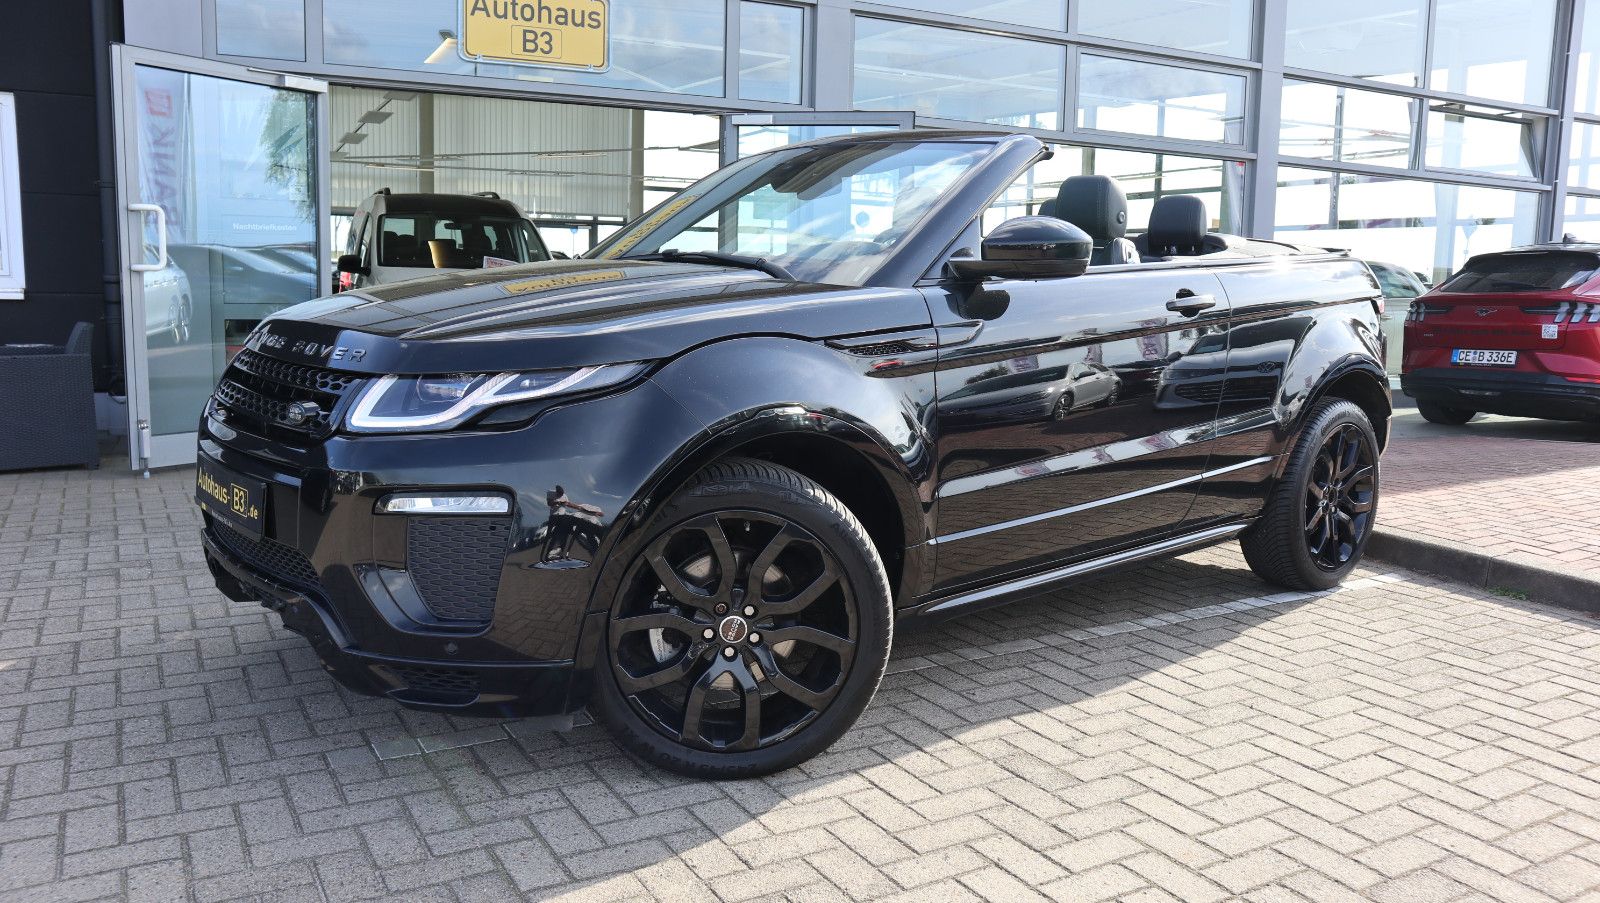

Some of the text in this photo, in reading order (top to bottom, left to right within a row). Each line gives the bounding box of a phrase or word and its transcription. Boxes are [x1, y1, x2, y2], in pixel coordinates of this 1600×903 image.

[470, 0, 602, 30] Autohaus
[522, 29, 554, 55] B3
[292, 341, 367, 362] ROVER
[1458, 350, 1514, 363] CE B 336E
